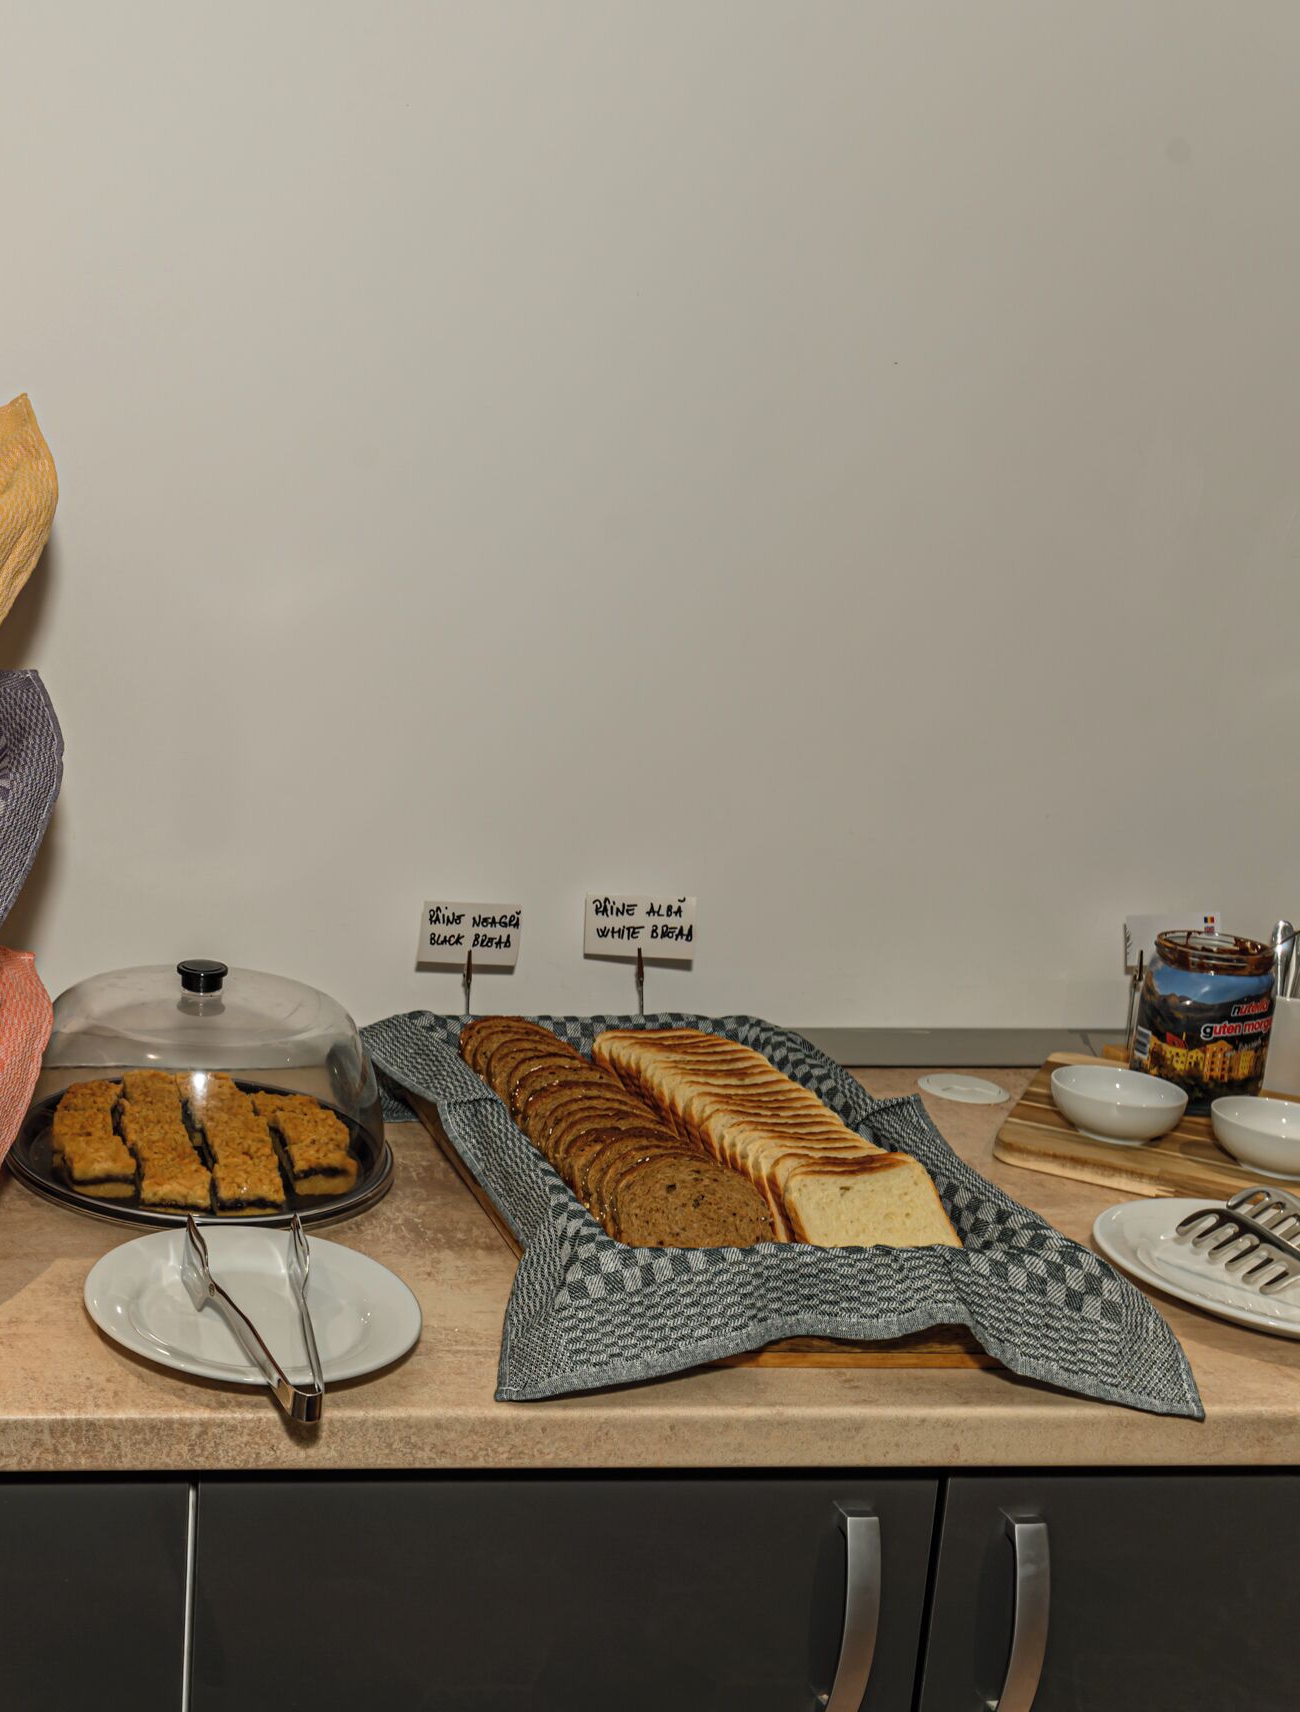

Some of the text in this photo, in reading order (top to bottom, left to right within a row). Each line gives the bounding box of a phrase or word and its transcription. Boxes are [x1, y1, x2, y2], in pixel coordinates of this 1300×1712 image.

[429, 932, 511, 949] BLACK BREAD
[650, 924, 693, 942] BREAD
[1200, 1016, 1273, 1040] guten morg
